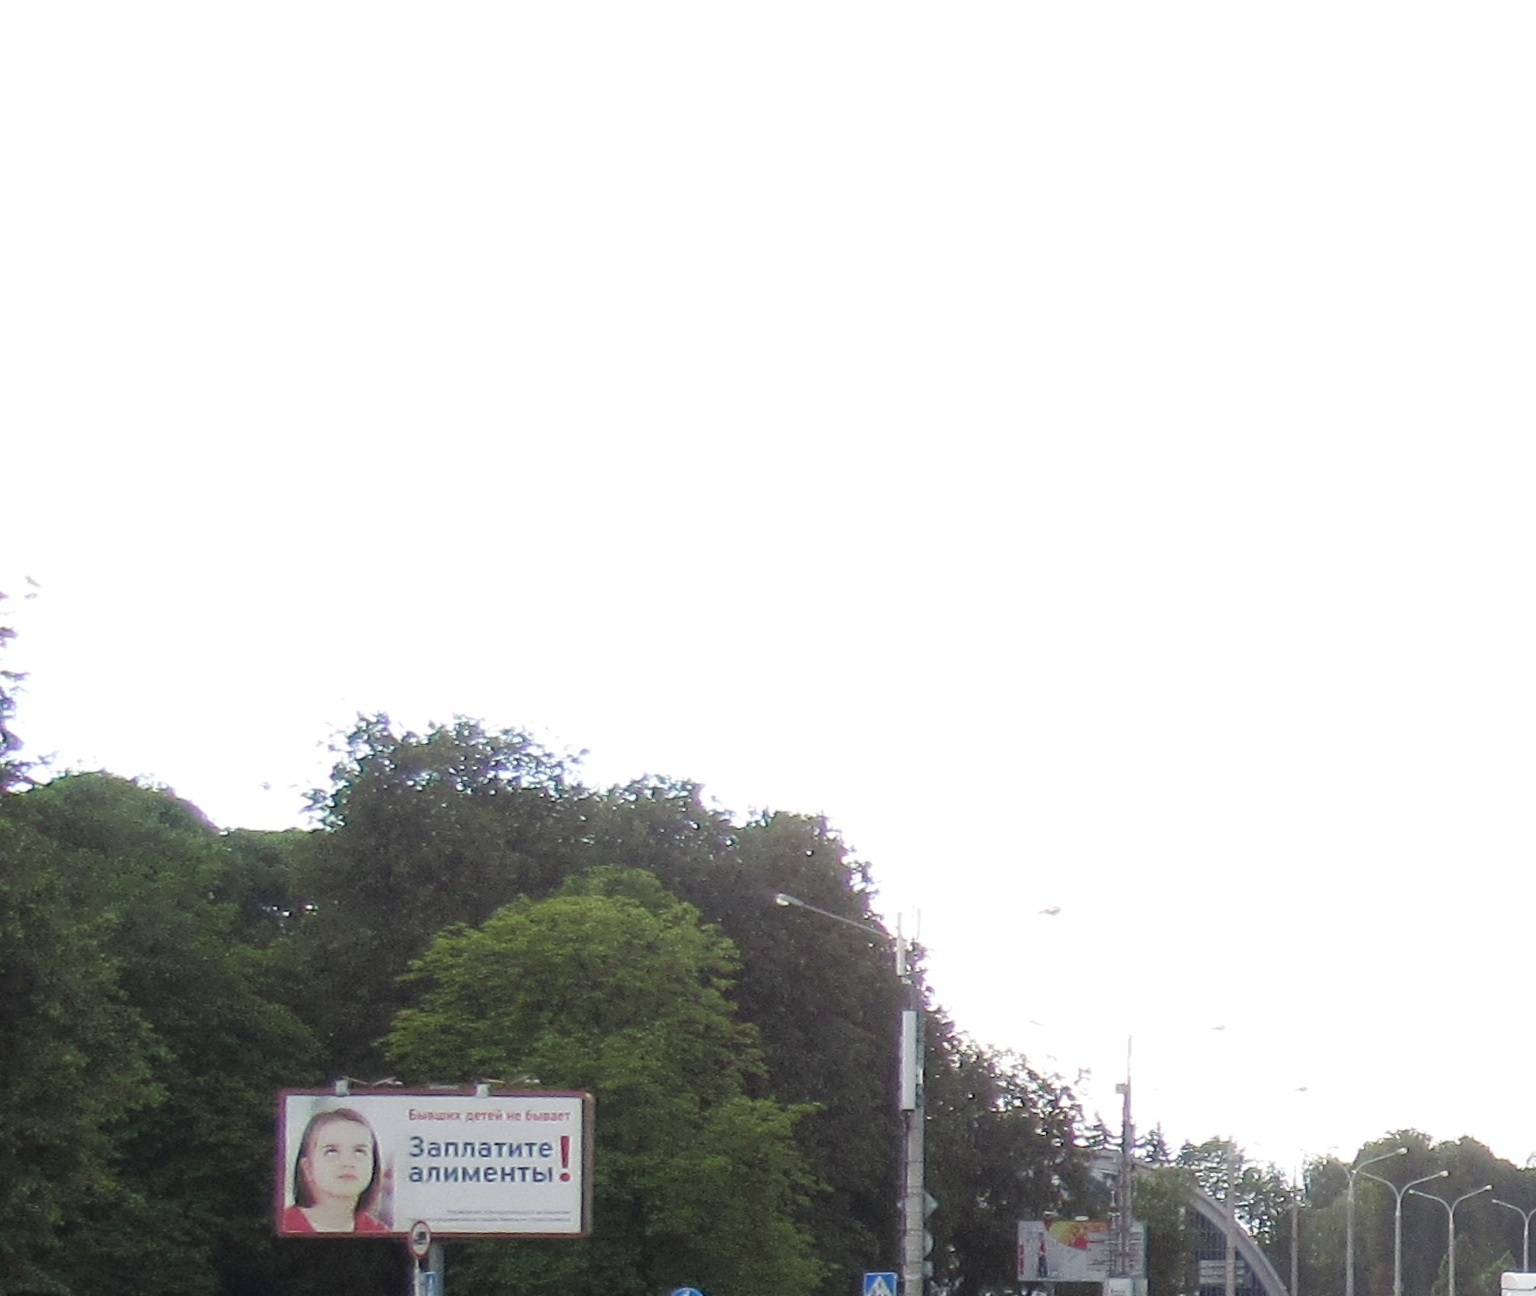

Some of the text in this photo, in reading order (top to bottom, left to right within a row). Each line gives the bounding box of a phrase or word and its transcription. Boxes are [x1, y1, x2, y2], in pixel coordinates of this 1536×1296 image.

[408, 1109, 572, 1122] Бывших детей не бывает
[409, 1136, 553, 1158] Заплатите
[409, 1166, 554, 1183] алименты
